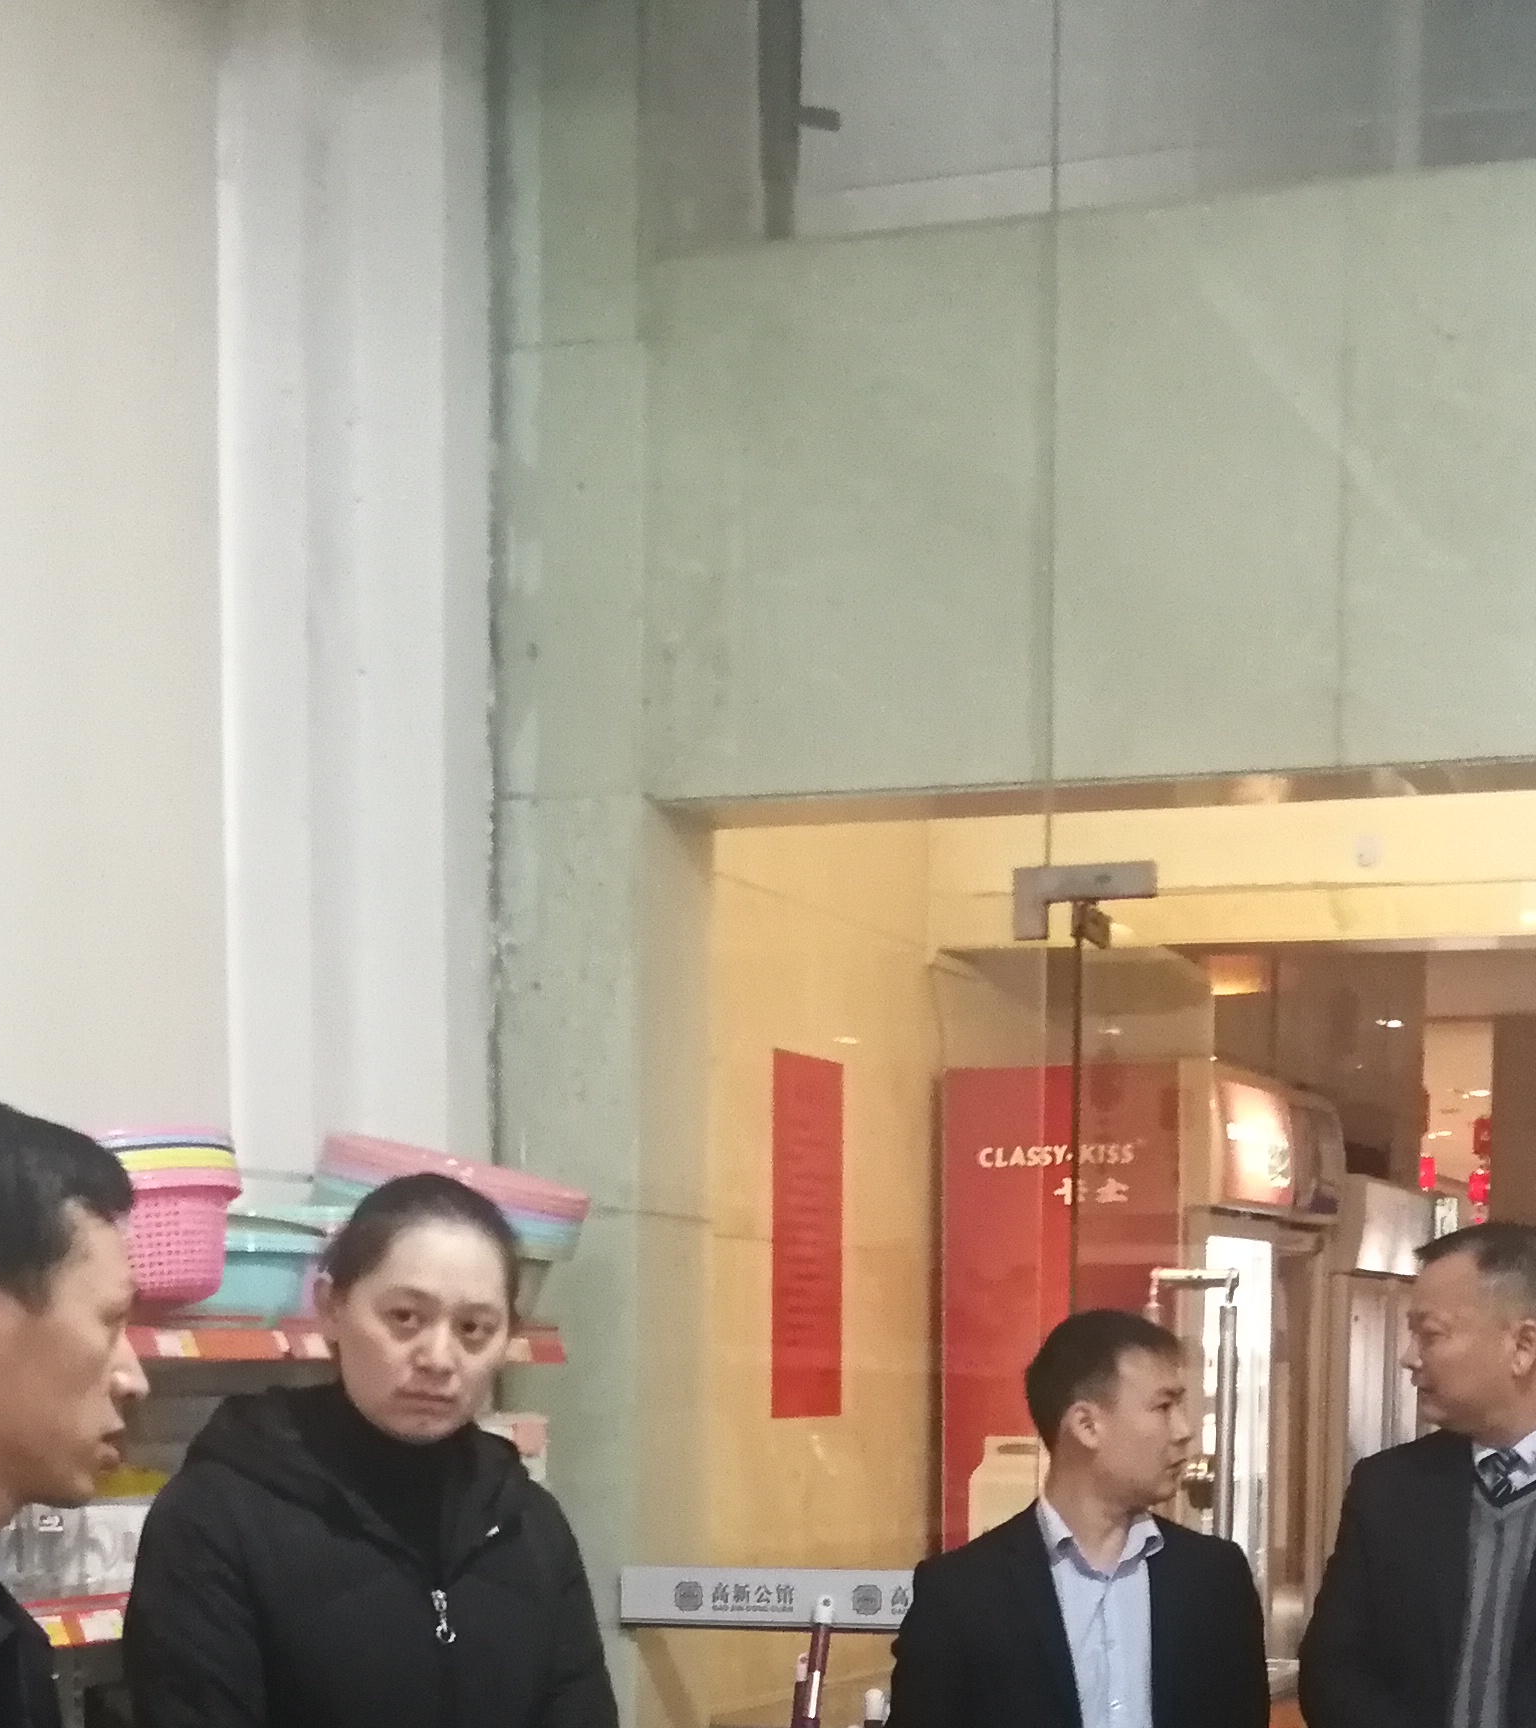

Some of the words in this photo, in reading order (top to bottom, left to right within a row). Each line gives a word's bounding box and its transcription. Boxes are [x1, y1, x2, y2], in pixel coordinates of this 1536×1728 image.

[1079, 1144, 1135, 1164] KISS
[712, 1582, 795, 1604] 高新公馆
